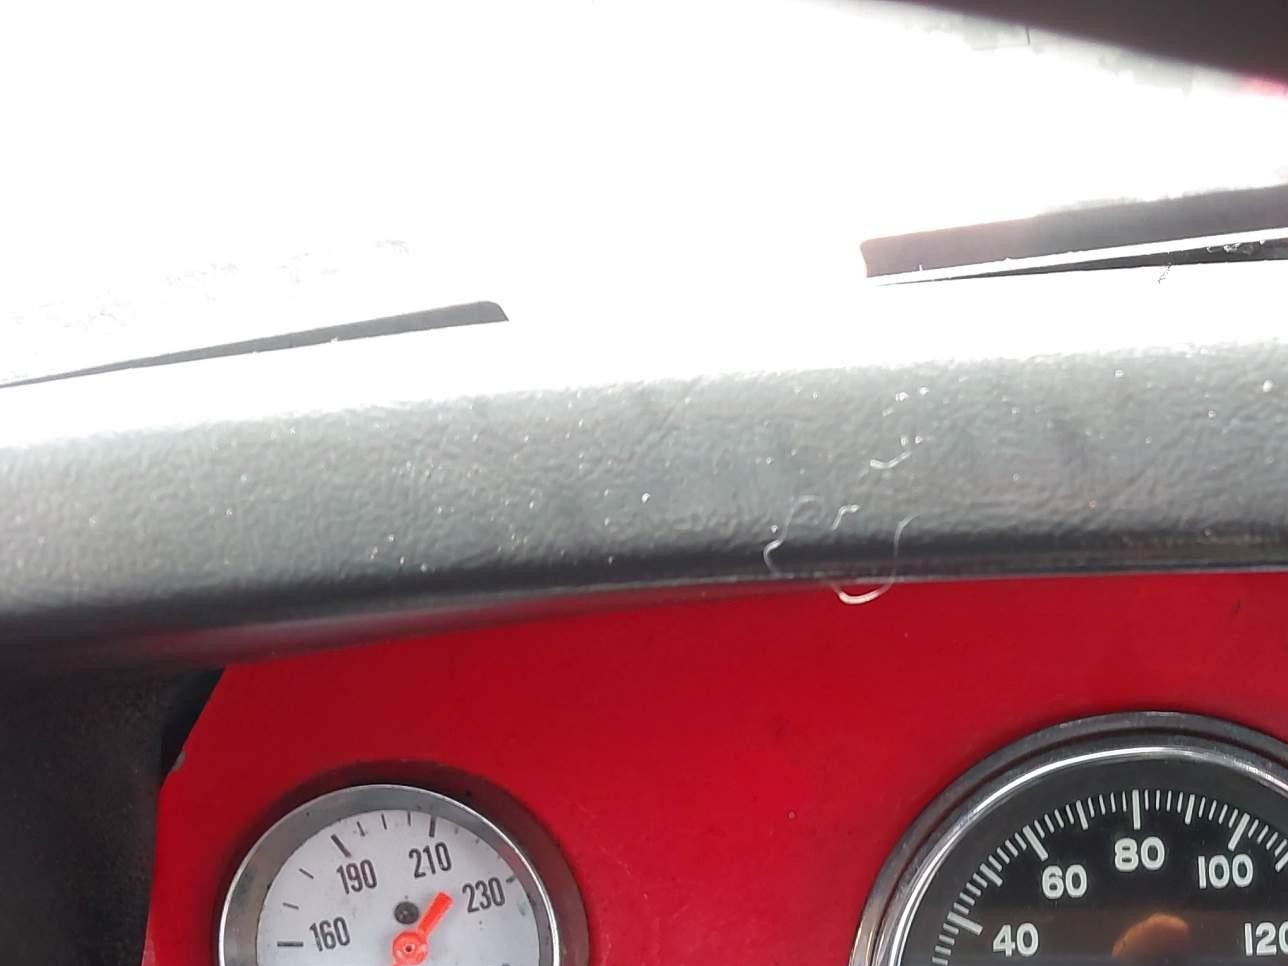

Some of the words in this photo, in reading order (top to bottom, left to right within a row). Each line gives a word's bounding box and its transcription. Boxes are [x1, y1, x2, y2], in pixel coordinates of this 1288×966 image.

[409, 842, 452, 880] 210
[1114, 837, 1165, 871] 80
[1198, 853, 1254, 889] 100
[336, 859, 378, 894] 190
[1041, 864, 1088, 898] 60
[462, 877, 506, 913] 230
[309, 916, 351, 952] 160
[992, 922, 1039, 957] 40
